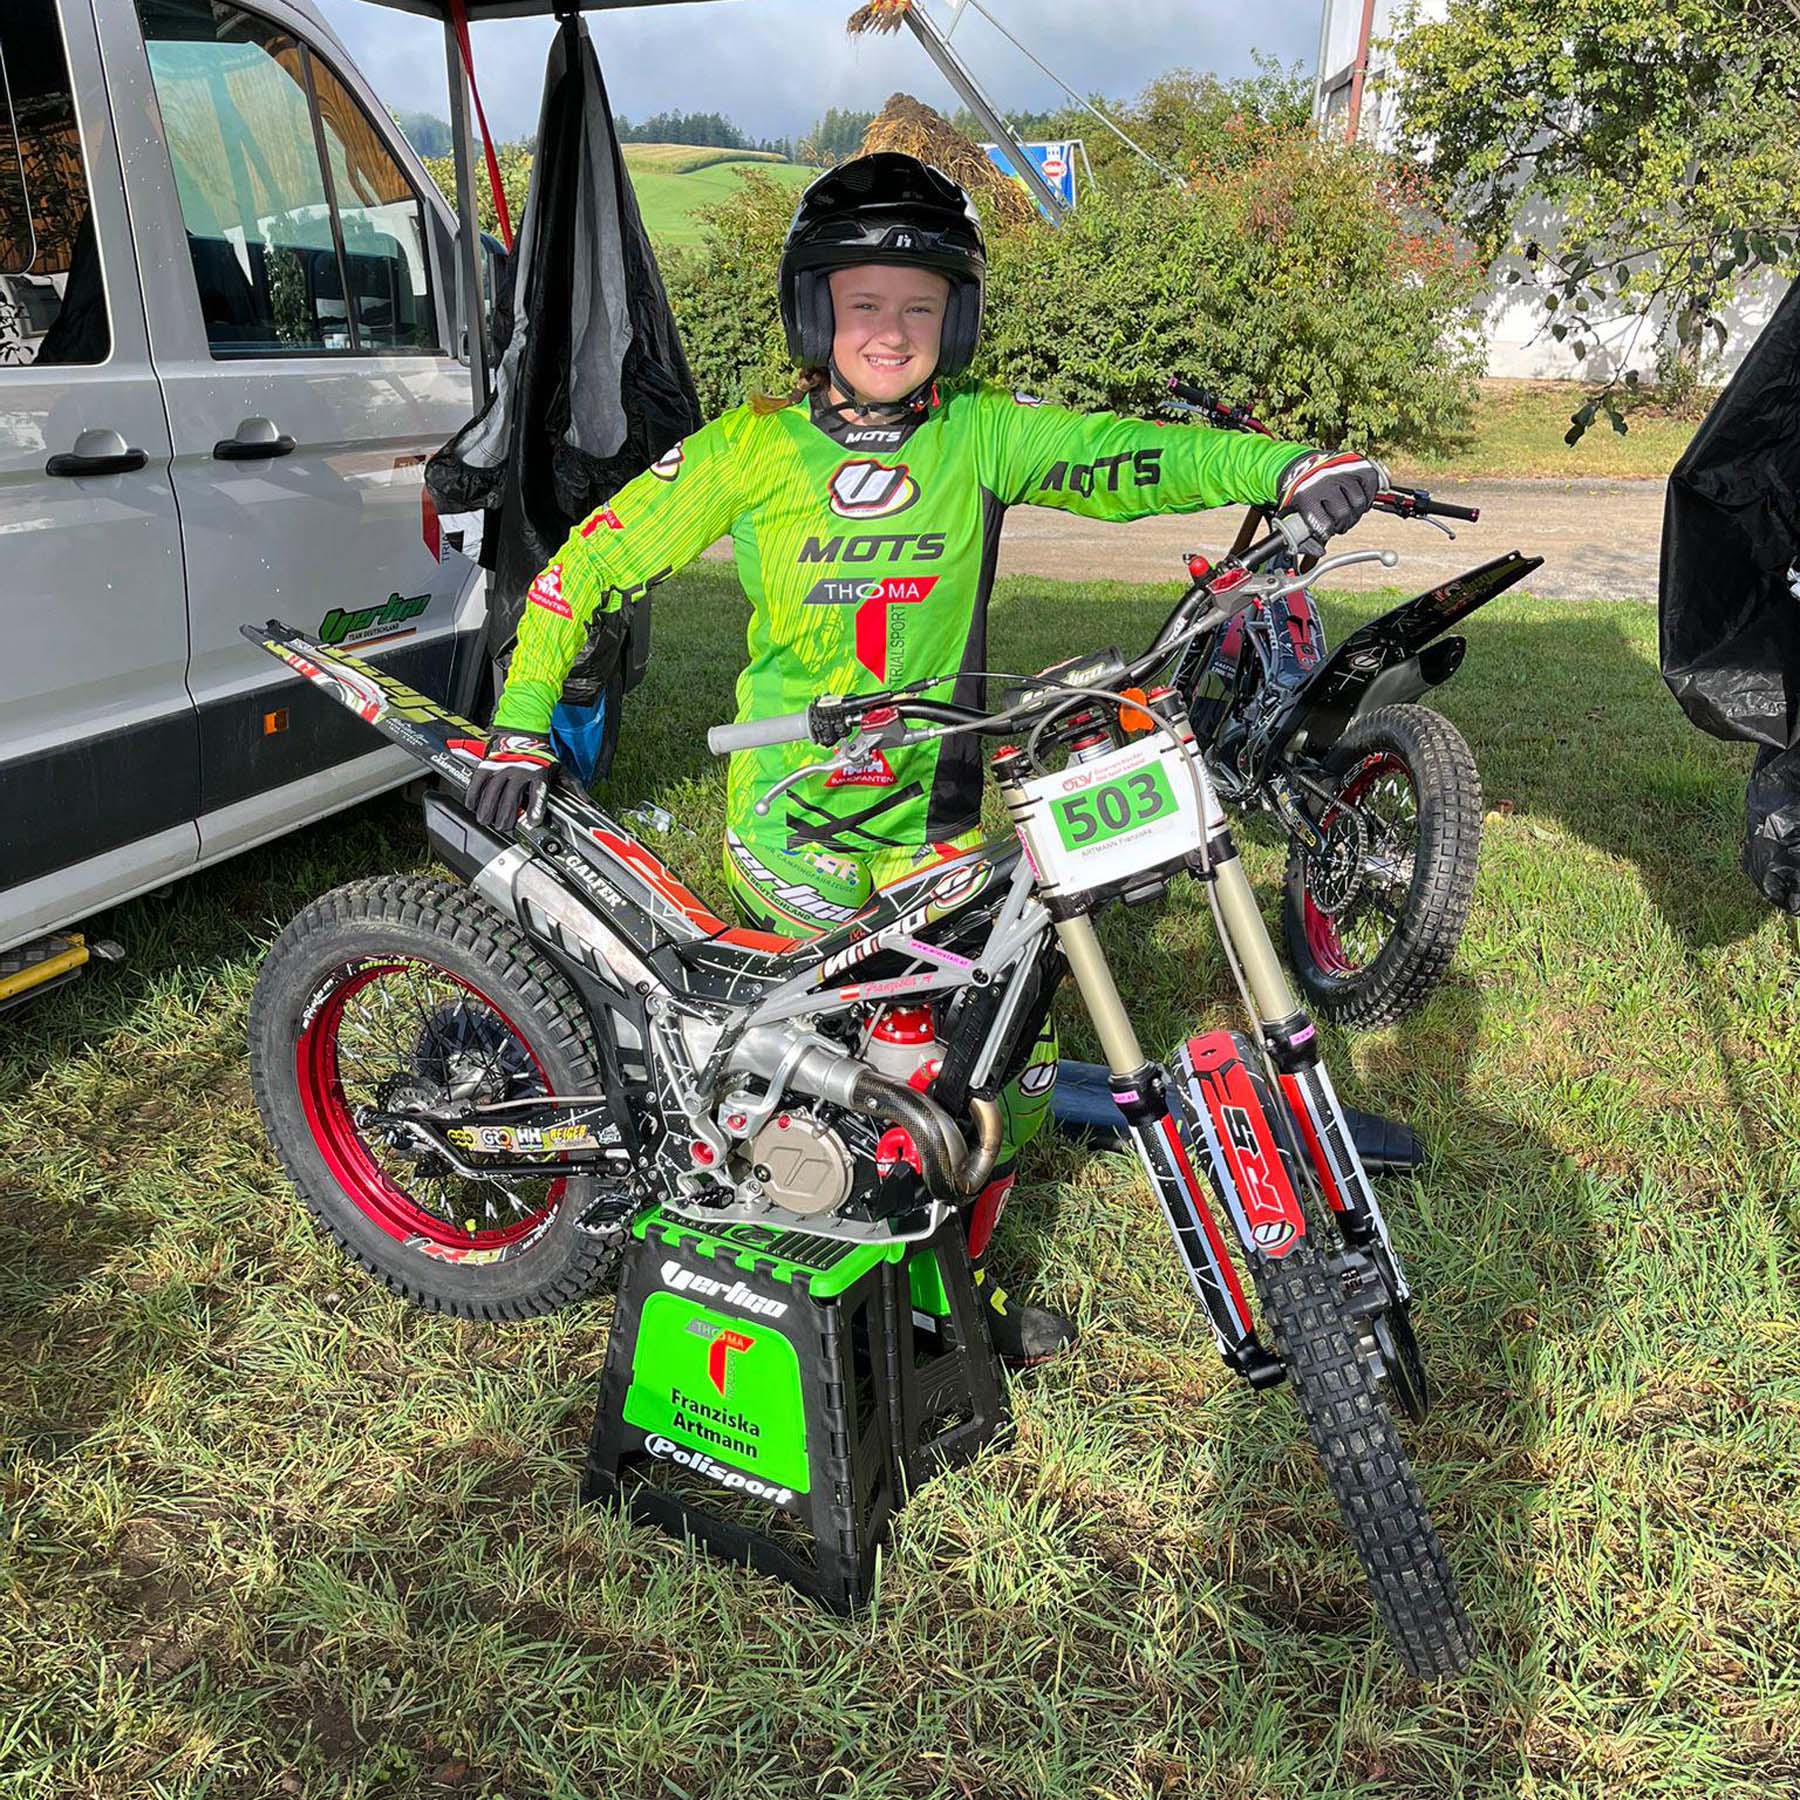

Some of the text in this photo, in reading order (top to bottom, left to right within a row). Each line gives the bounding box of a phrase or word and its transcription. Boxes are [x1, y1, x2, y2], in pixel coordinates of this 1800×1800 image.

[846, 430, 901, 443] MOTS
[797, 532, 946, 563] MOTS
[824, 583, 920, 600] THOMA
[888, 605, 905, 685] TRIALSPORT
[1062, 772, 1163, 843] 503
[566, 855, 622, 907] GALFER
[671, 1388, 760, 1437] Franziska
[672, 1411, 759, 1459] Artmann
[645, 1433, 793, 1505] Polisport
